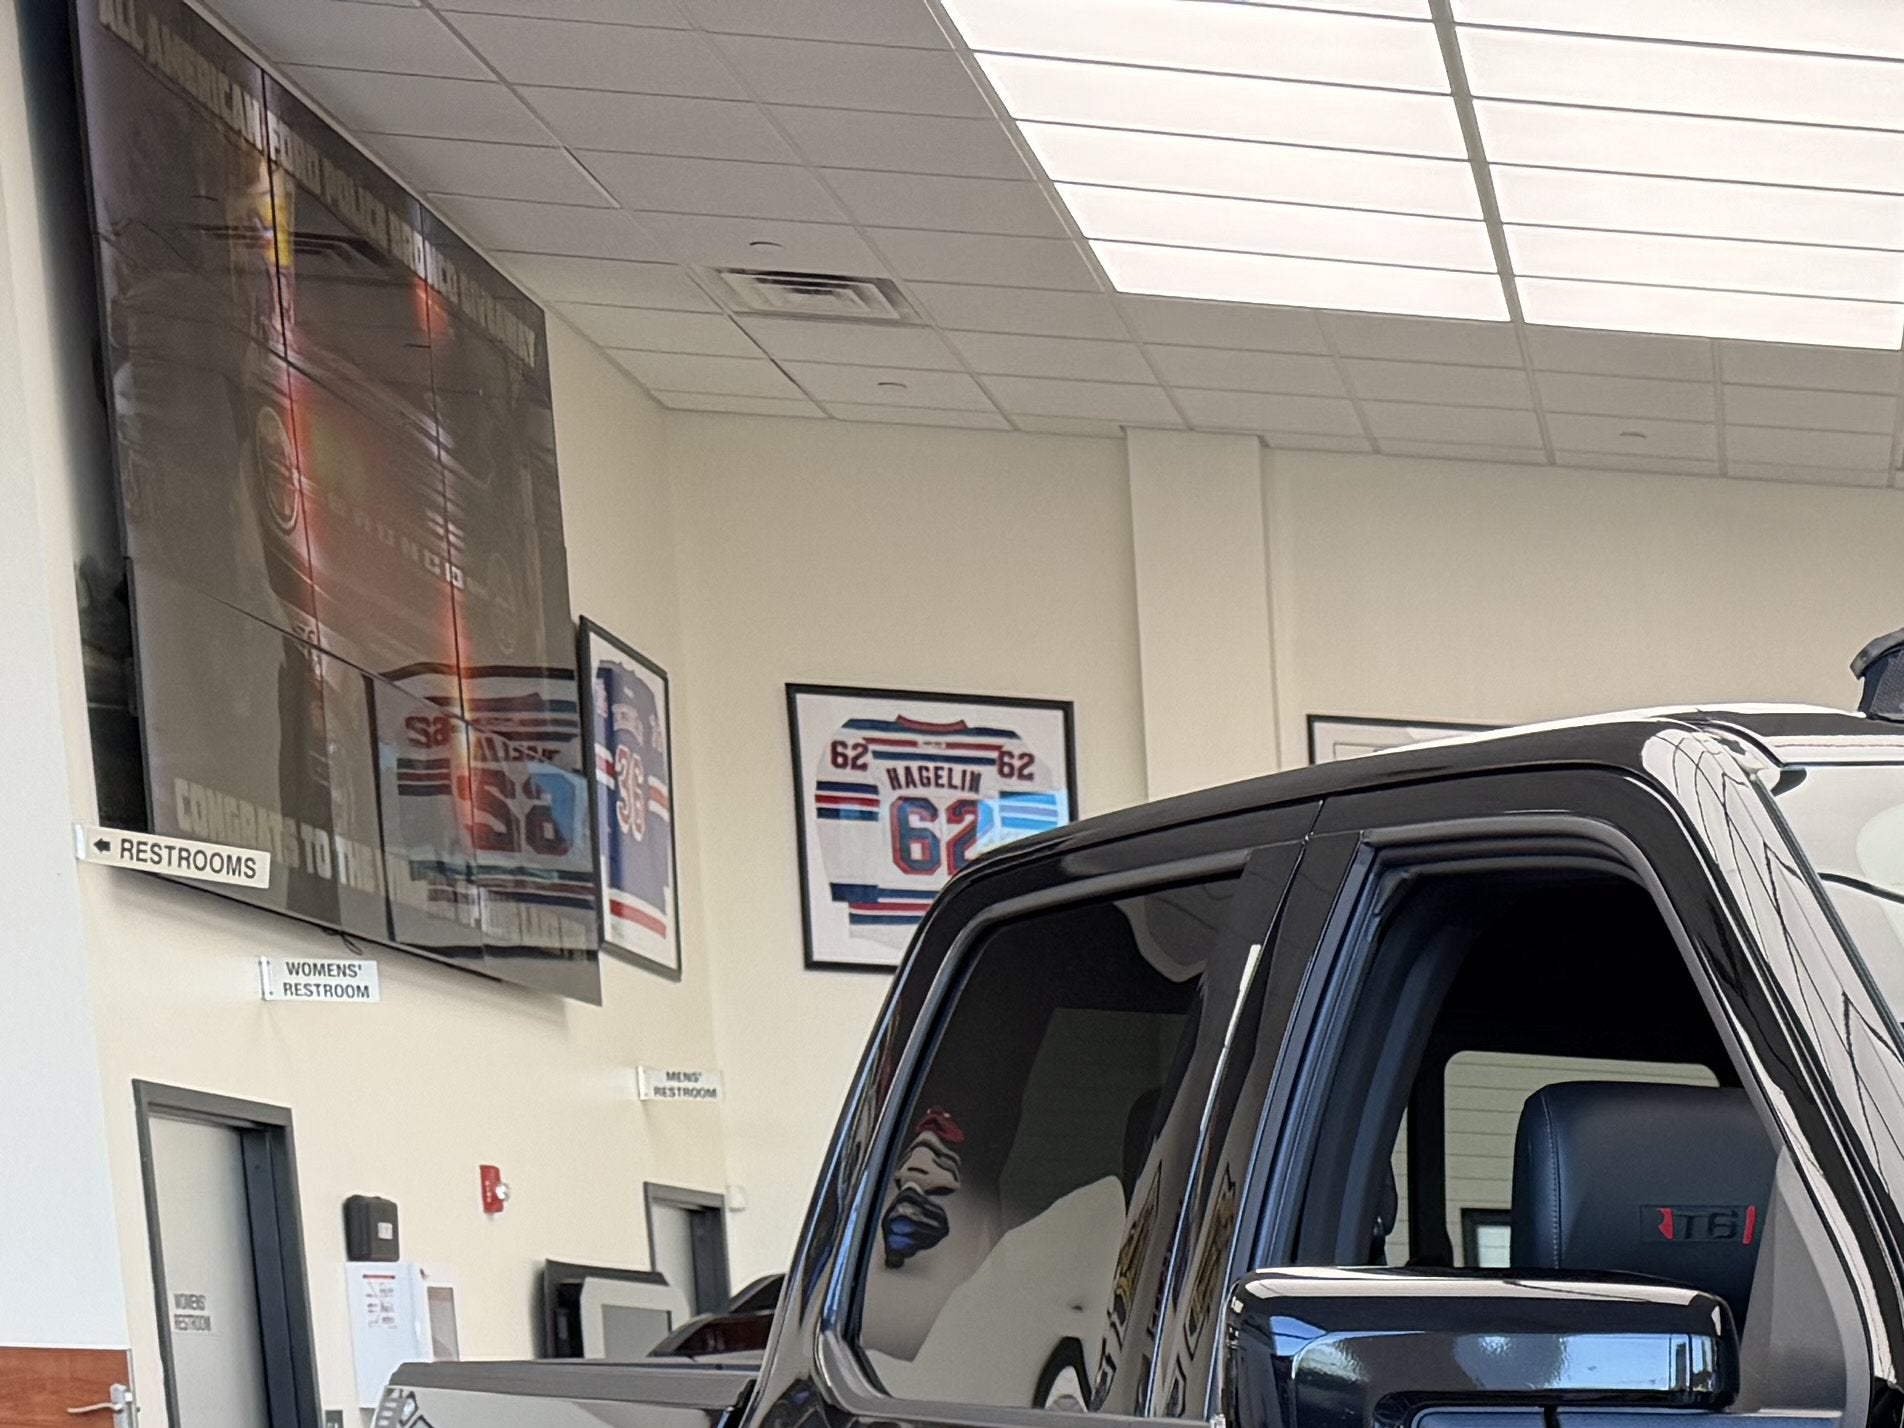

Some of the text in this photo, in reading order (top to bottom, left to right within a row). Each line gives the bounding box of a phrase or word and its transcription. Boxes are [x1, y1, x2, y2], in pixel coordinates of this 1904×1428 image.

[831, 740, 869, 772] 62
[997, 751, 1035, 782] 62
[886, 765, 982, 794] HAGELIN
[890, 796, 994, 876] 62
[119, 837, 257, 879] RESTROOMS
[301, 825, 332, 879] TO
[285, 961, 362, 978] WOMENS'
[283, 982, 370, 999] RESTROOM
[654, 1086, 717, 1098] RESTROOM
